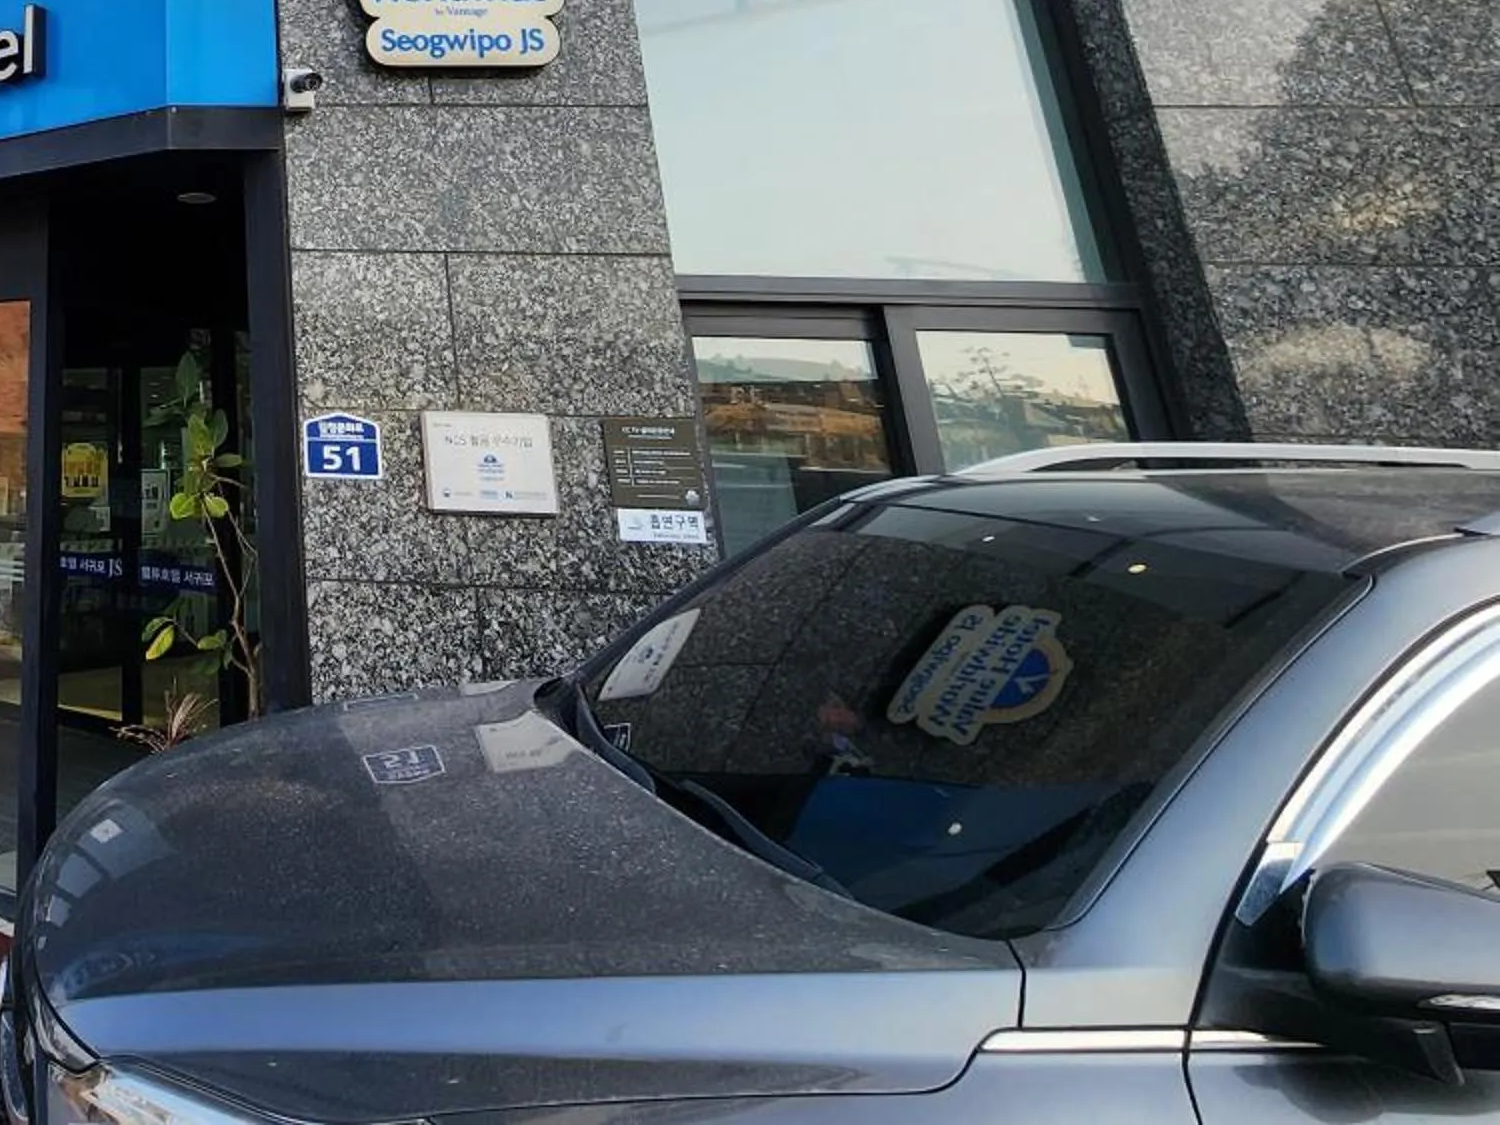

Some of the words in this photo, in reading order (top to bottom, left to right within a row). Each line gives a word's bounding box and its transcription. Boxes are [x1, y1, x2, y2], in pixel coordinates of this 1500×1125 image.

[381, 29, 511, 59] Seogwipo
[519, 28, 545, 54] JS
[323, 445, 361, 472] 51
